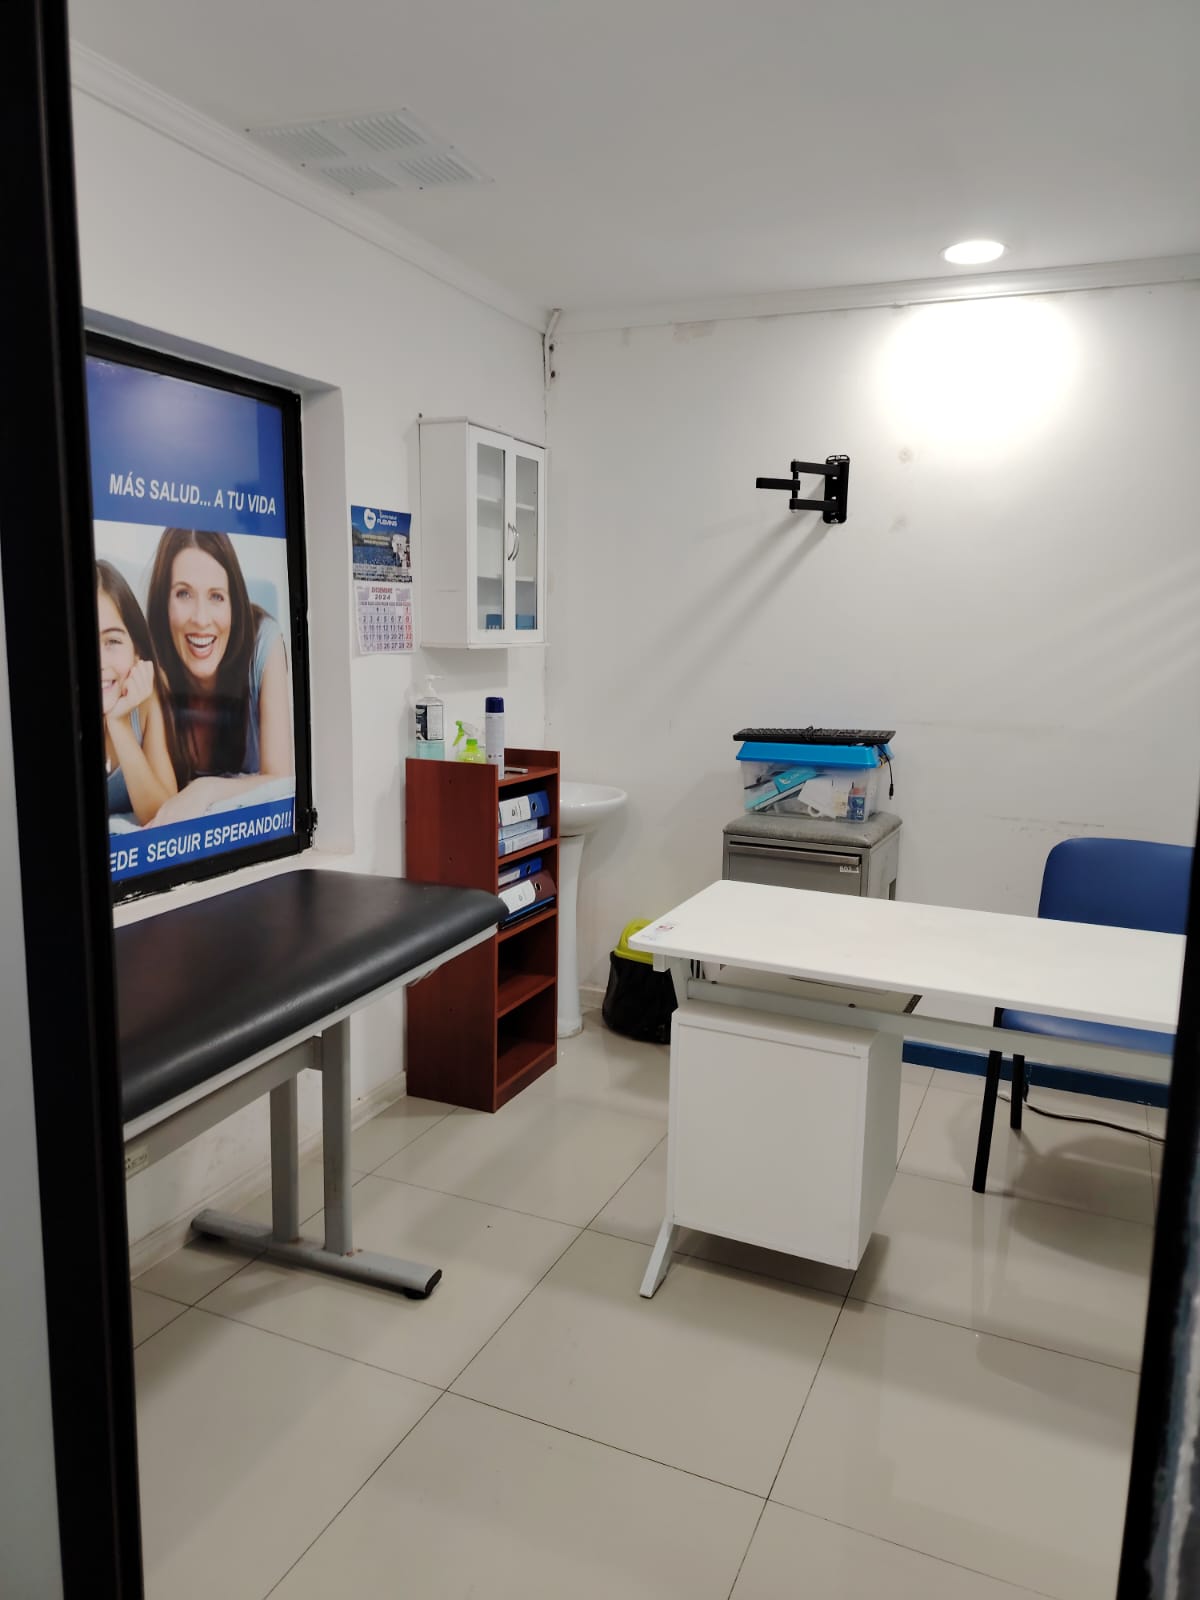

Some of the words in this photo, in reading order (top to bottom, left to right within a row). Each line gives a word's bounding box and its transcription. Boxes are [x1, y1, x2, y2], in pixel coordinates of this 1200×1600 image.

[109, 471, 145, 498] MÁS
[150, 479, 211, 507] SALUD...
[214, 489, 224, 508] A
[227, 491, 245, 511] TU
[247, 494, 277, 515] VIDA
[146, 832, 201, 863] SEGUIR
[204, 810, 292, 848] ESPERANDO!!!
